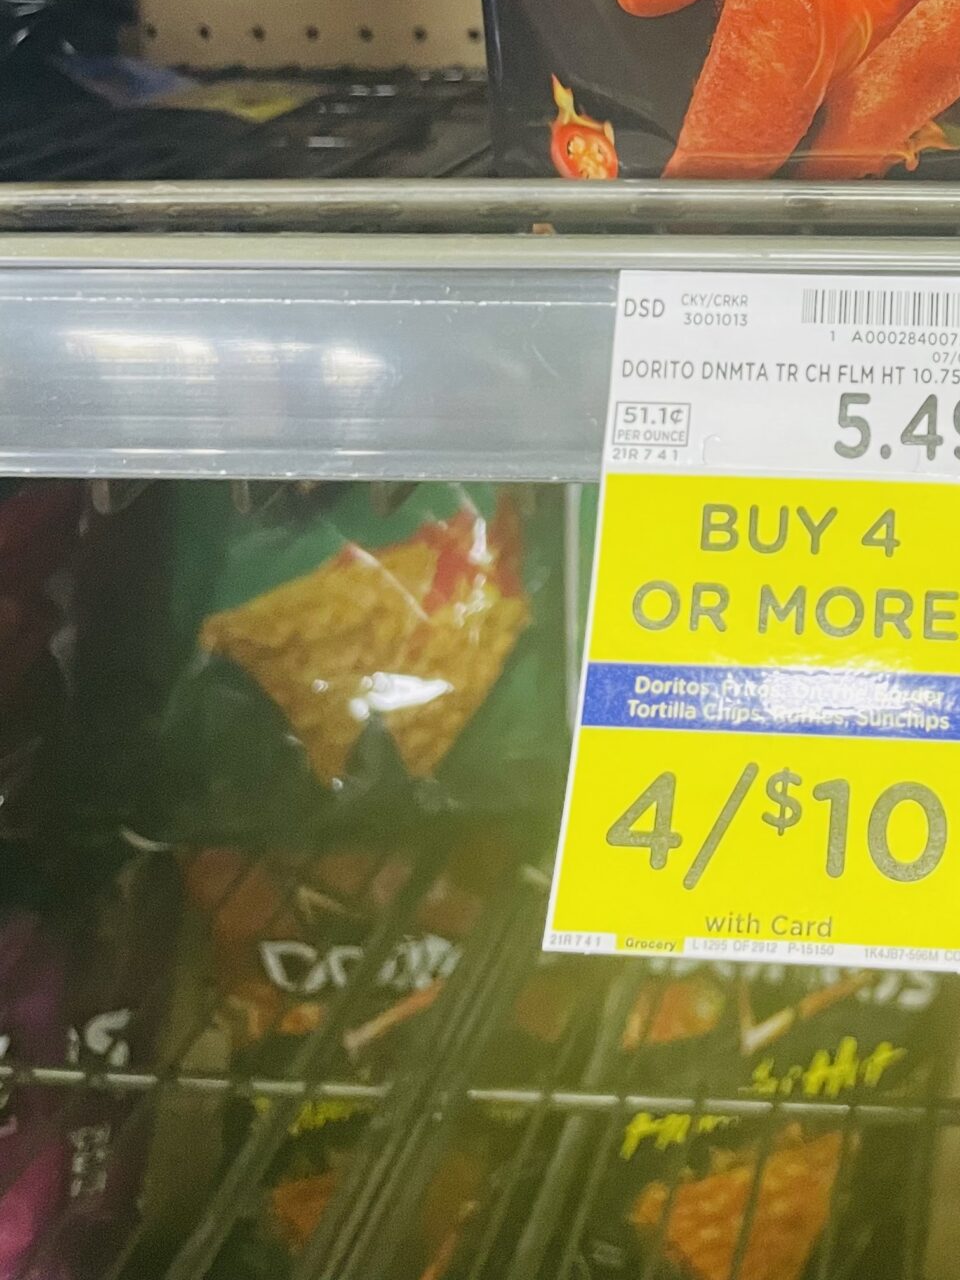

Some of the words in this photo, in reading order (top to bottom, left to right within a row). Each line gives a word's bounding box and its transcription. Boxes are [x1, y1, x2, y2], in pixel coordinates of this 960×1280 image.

[623, 298, 665, 318] DSD
[681, 293, 749, 309] CKY/CRKR
[684, 313, 748, 326] 3001013
[622, 359, 695, 379] DORITO
[702, 361, 768, 382] DNMTA
[776, 363, 799, 382] TR
[805, 364, 831, 383] CH
[838, 365, 874, 384] FLM
[882, 366, 905, 385] HT
[913, 368, 960, 385] 10.75
[623, 406, 684, 424] 51.1¢
[617, 429, 640, 441] PER
[643, 430, 686, 442] OUNCE
[700, 504, 838, 555] BUY
[861, 508, 900, 558] 4
[632, 580, 730, 632] OR
[758, 584, 960, 641] MORE
[627, 700, 697, 720] Tortilla
[606, 762, 948, 890] 4/$10
[705, 912, 760, 934] with
[771, 915, 833, 937] Card
[625, 937, 676, 952] Grocery
[733, 940, 749, 952] OF
